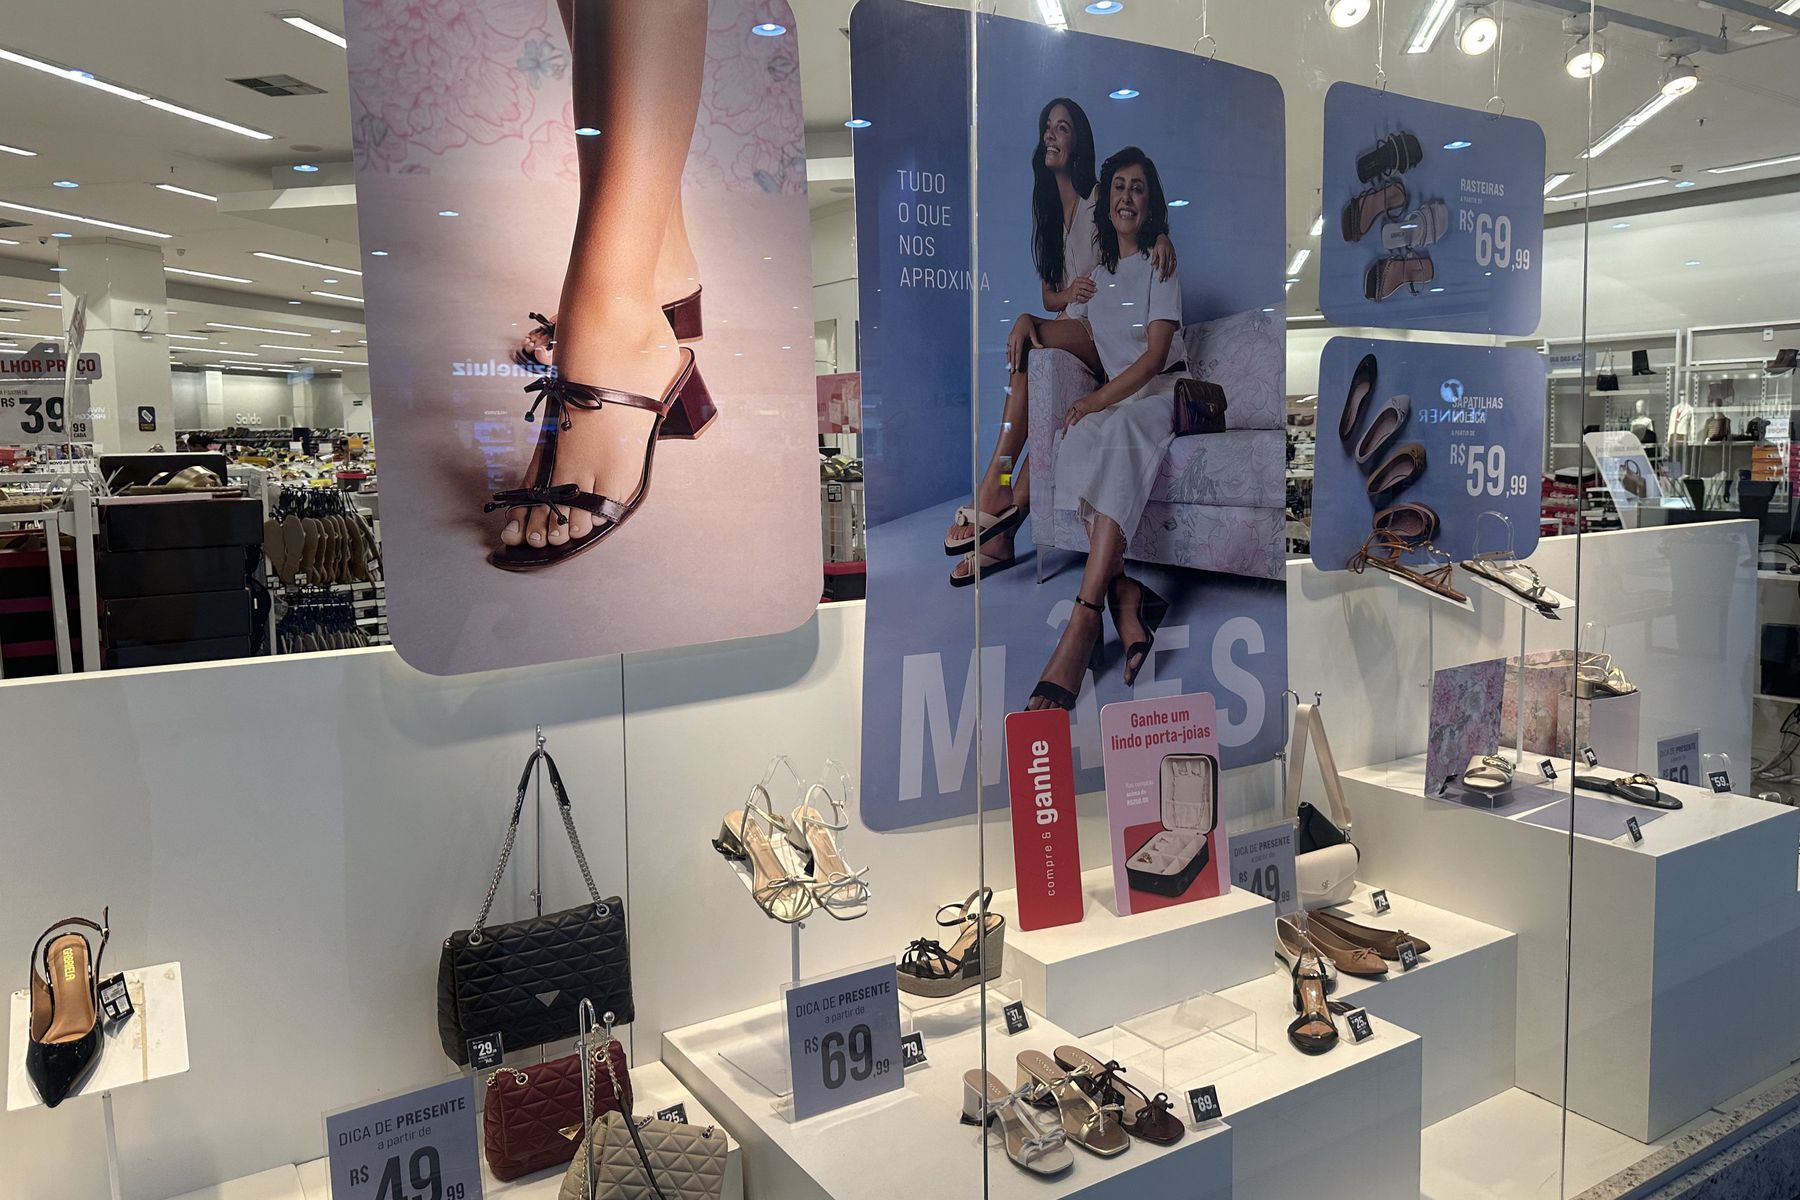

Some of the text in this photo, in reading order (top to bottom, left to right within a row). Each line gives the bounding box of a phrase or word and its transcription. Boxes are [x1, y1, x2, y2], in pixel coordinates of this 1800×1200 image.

[897, 169, 945, 194] TUDO
[1460, 178, 1505, 197] RASTEIRAS
[898, 202, 951, 226] O QUE
[1459, 208, 1474, 234] R$
[899, 234, 935, 256] NOS
[46, 358, 96, 374] PRÇO
[1451, 395, 1504, 409] SAPATILHAS
[1, 396, 65, 434] R$ 39
[235, 412, 262, 425] Saldo
[72, 422, 86, 433] 99
[1450, 443, 1465, 466] R$
[1130, 710, 1190, 728] Ganhe um
[1111, 724, 1211, 751] lindo porta-joias
[1027, 739, 1059, 825] ganhe
[1233, 846, 1249, 857] DICA
[1258, 835, 1291, 852] PRESENTE
[1045, 844, 1056, 896] compre
[795, 981, 891, 1018] DICA DE PRESENTE
[824, 1004, 865, 1024] a partir de
[804, 1035, 819, 1055] R$
[338, 1096, 466, 1147] DICA DE PRESENTE
[377, 1125, 432, 1151] a partir de
[349, 1164, 370, 1187] R$
